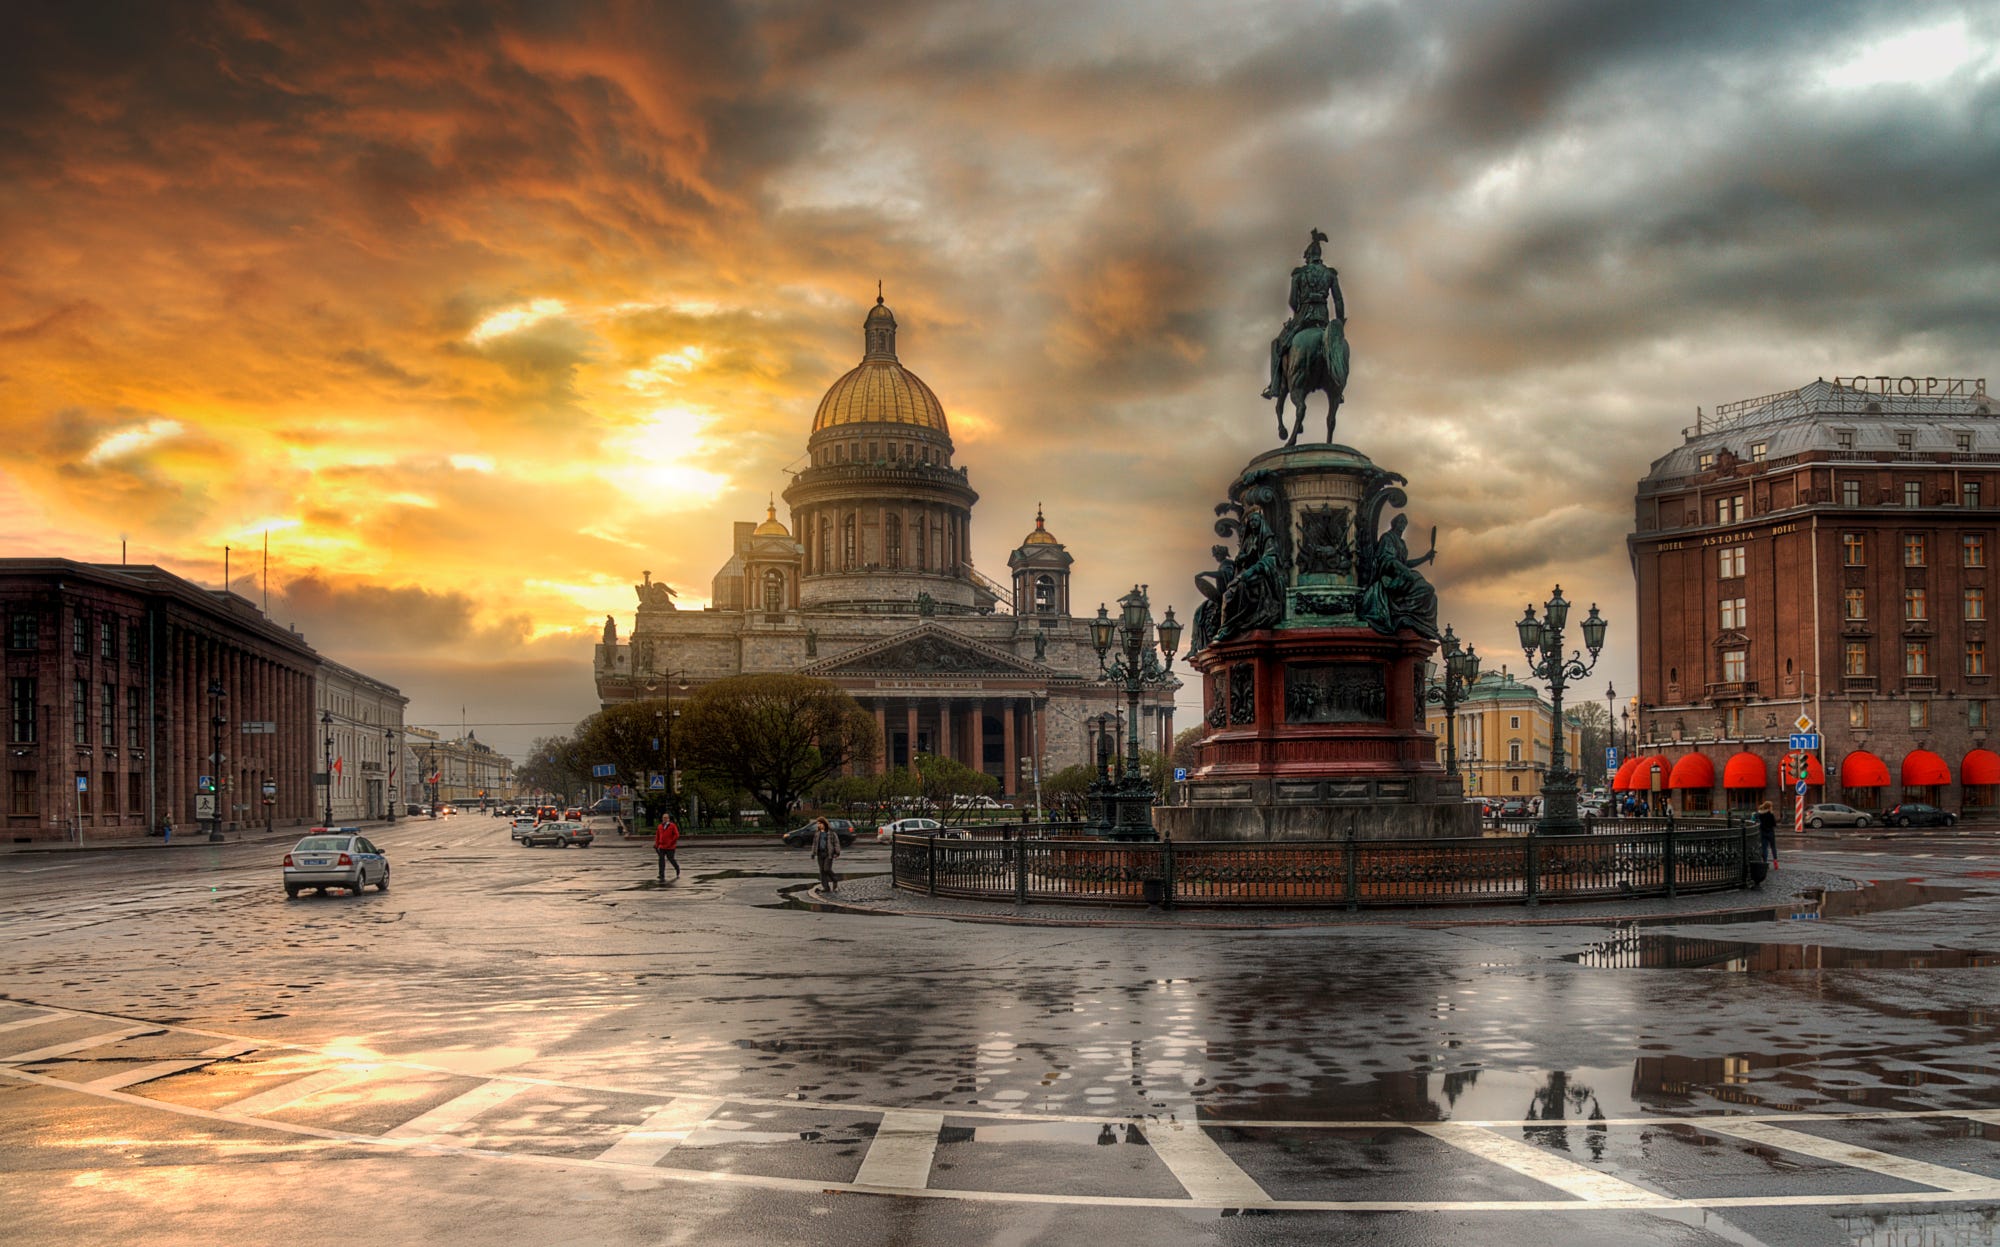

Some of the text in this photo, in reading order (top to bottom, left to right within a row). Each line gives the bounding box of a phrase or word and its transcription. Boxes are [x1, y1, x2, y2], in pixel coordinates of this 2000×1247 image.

[1828, 375, 1986, 398] АСТОРИЯ
[1658, 523, 1797, 552] HOTEL ASTORIA HOTEL
